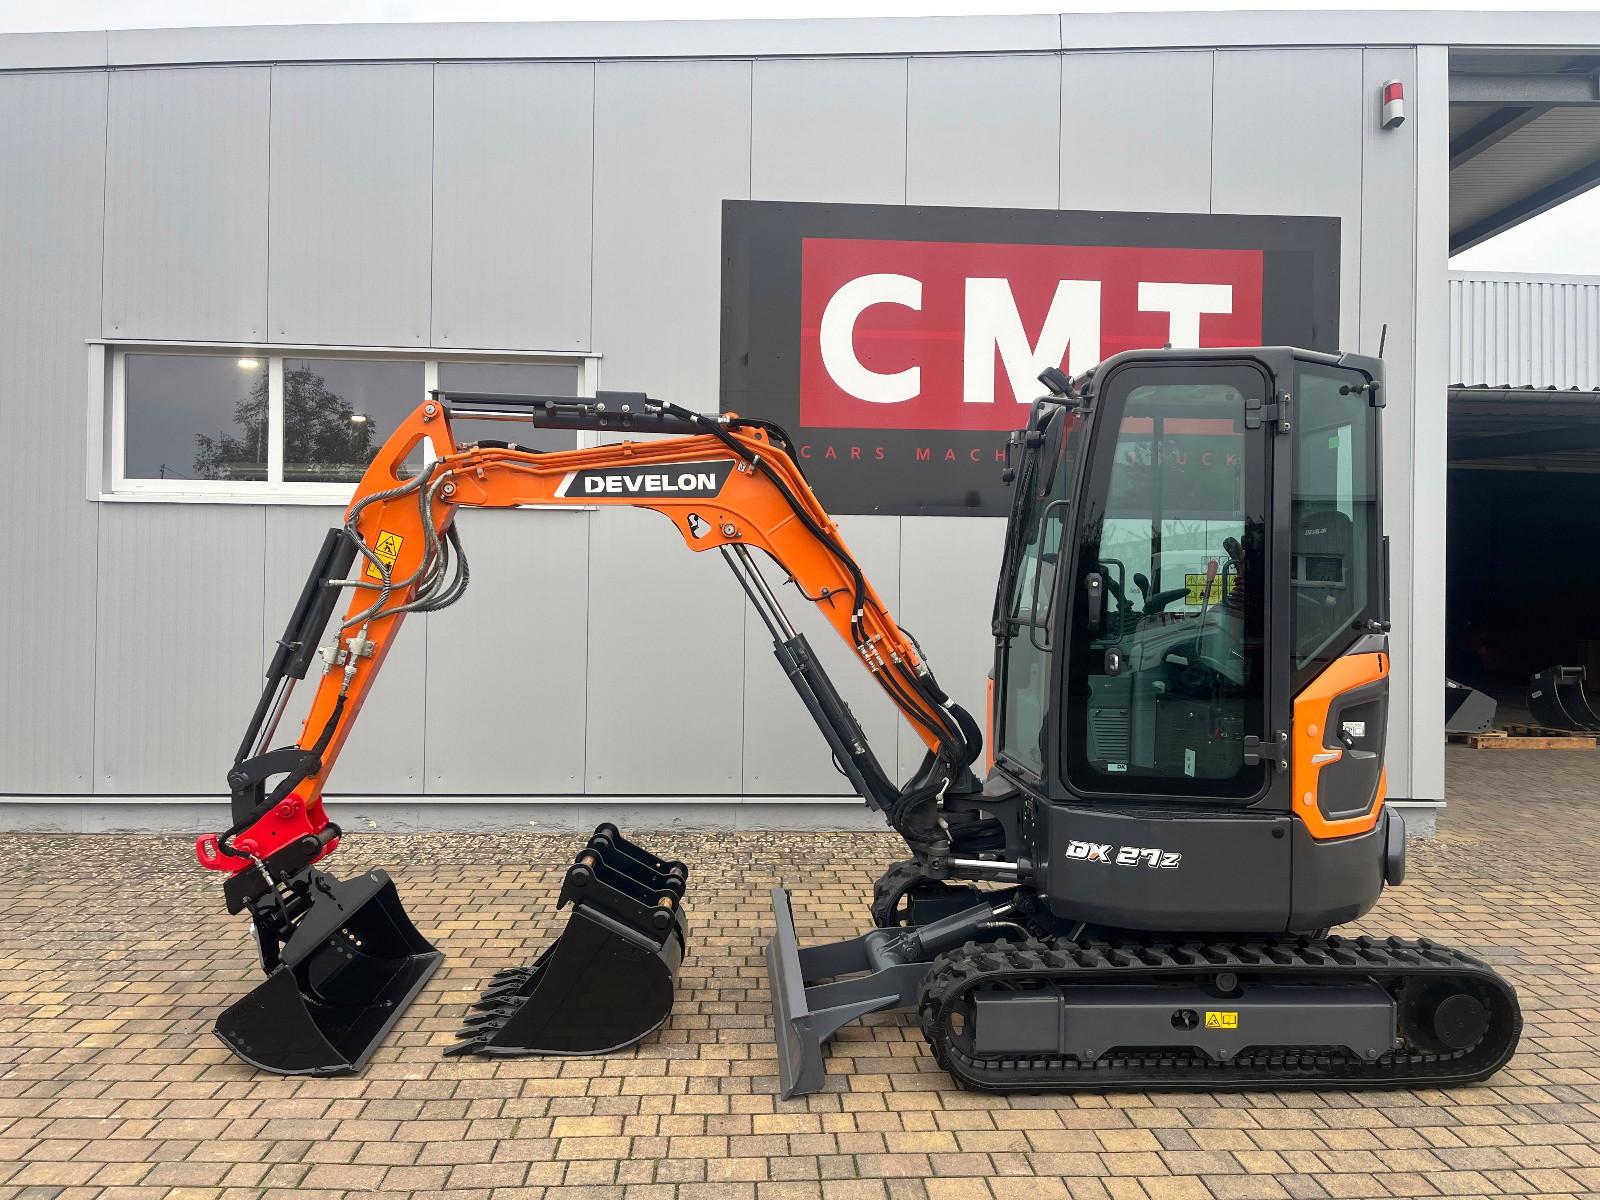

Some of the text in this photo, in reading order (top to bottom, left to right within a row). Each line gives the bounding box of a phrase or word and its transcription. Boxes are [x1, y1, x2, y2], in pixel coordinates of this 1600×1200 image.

[820, 273, 1233, 404] CMT
[800, 445, 885, 460] CARS
[584, 473, 717, 493] DEVELON
[1065, 840, 1113, 864] DX
